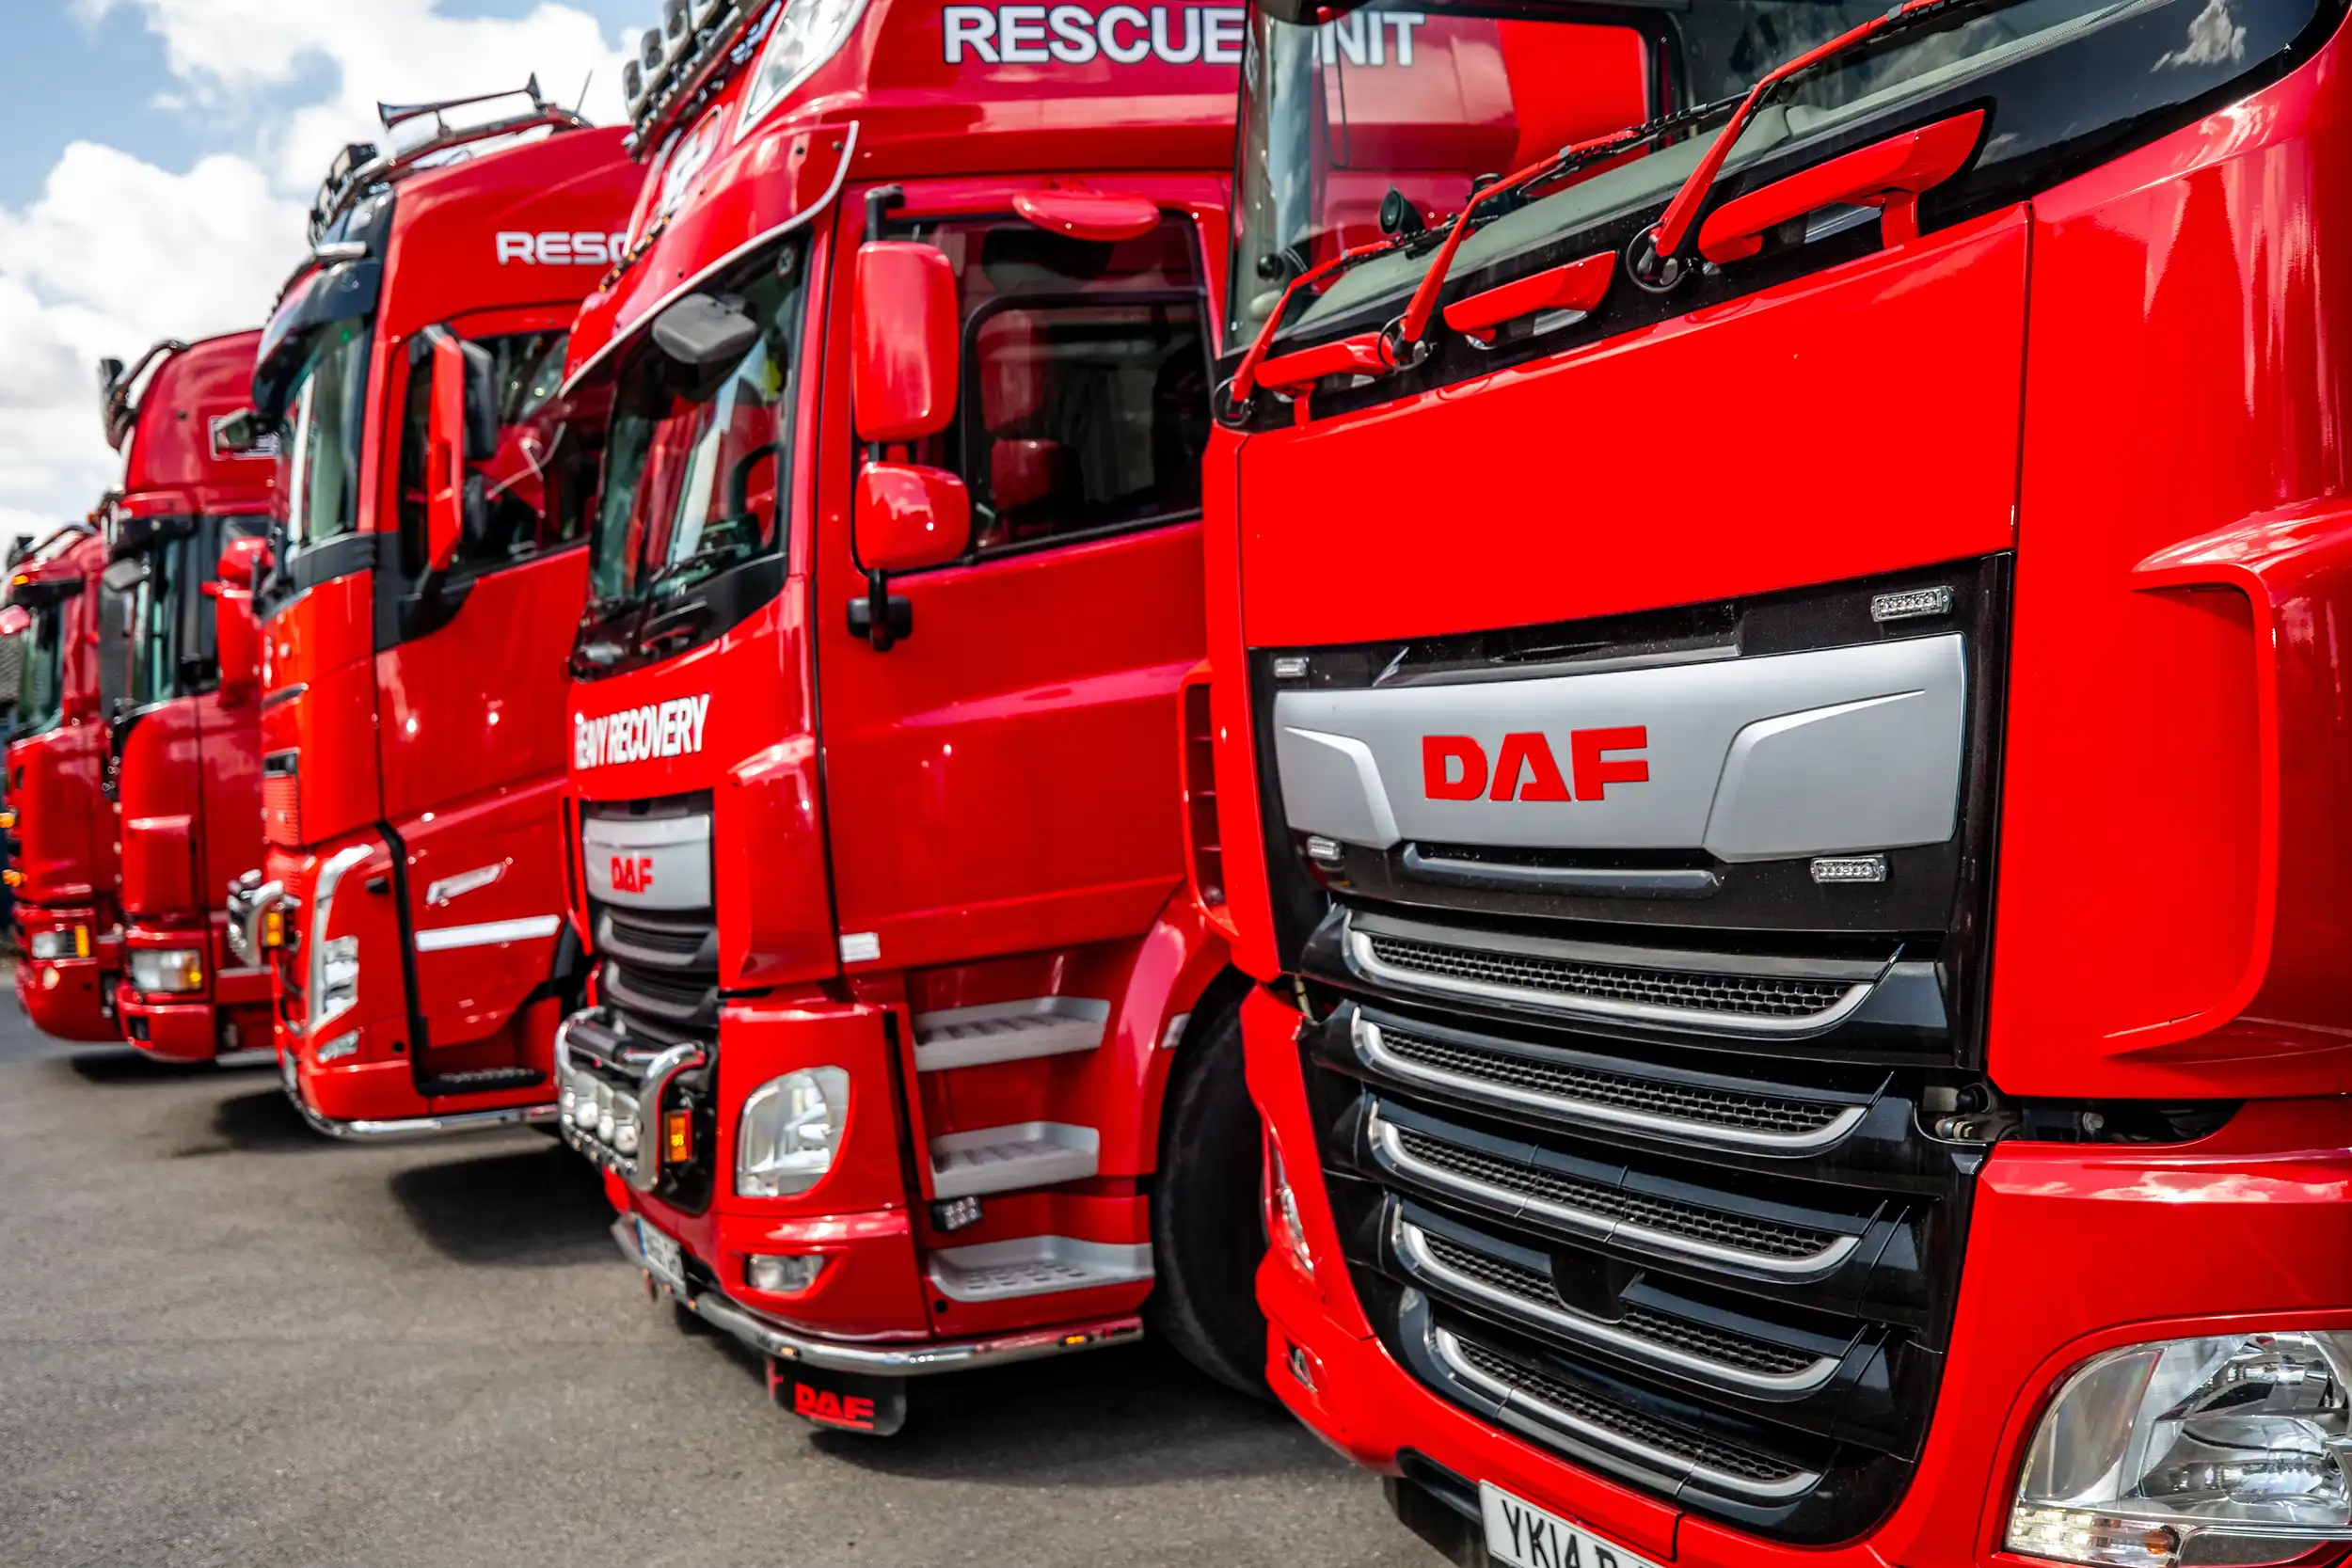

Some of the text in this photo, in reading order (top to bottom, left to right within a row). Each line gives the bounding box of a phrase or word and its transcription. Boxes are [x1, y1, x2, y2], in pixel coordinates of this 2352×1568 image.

[944, 5, 1425, 67] RESCUE NIT
[607, 692, 710, 766] RECOVERY
[1422, 724, 1650, 802] DAF
[610, 855, 654, 895] DAF
[794, 1381, 874, 1422] DAF
